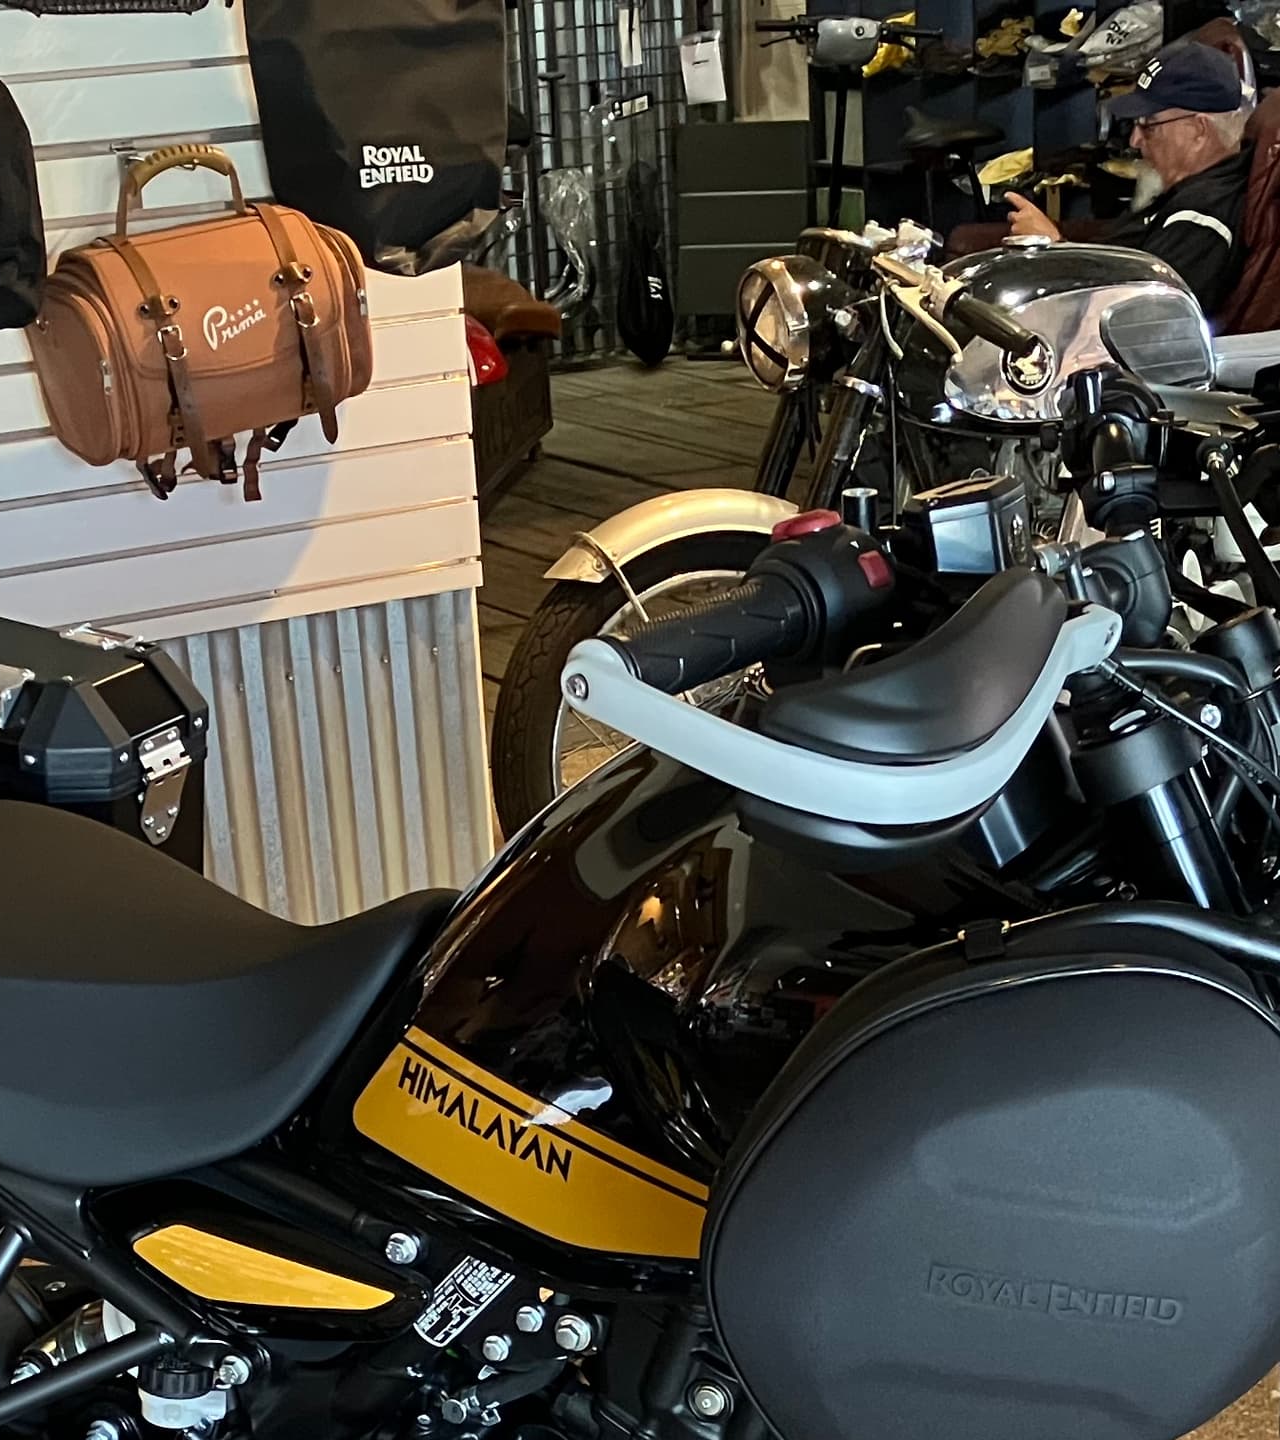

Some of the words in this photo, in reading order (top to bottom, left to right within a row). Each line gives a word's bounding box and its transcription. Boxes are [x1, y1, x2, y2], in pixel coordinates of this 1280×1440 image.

[360, 164, 434, 189] ENFIELD
[362, 145, 426, 167] ROYAL
[203, 305, 267, 351] Prima
[397, 1056, 573, 1183] HIMALAYAN
[927, 1262, 1040, 1308] ROYAL
[1046, 1280, 1184, 1327] ENFIELD
